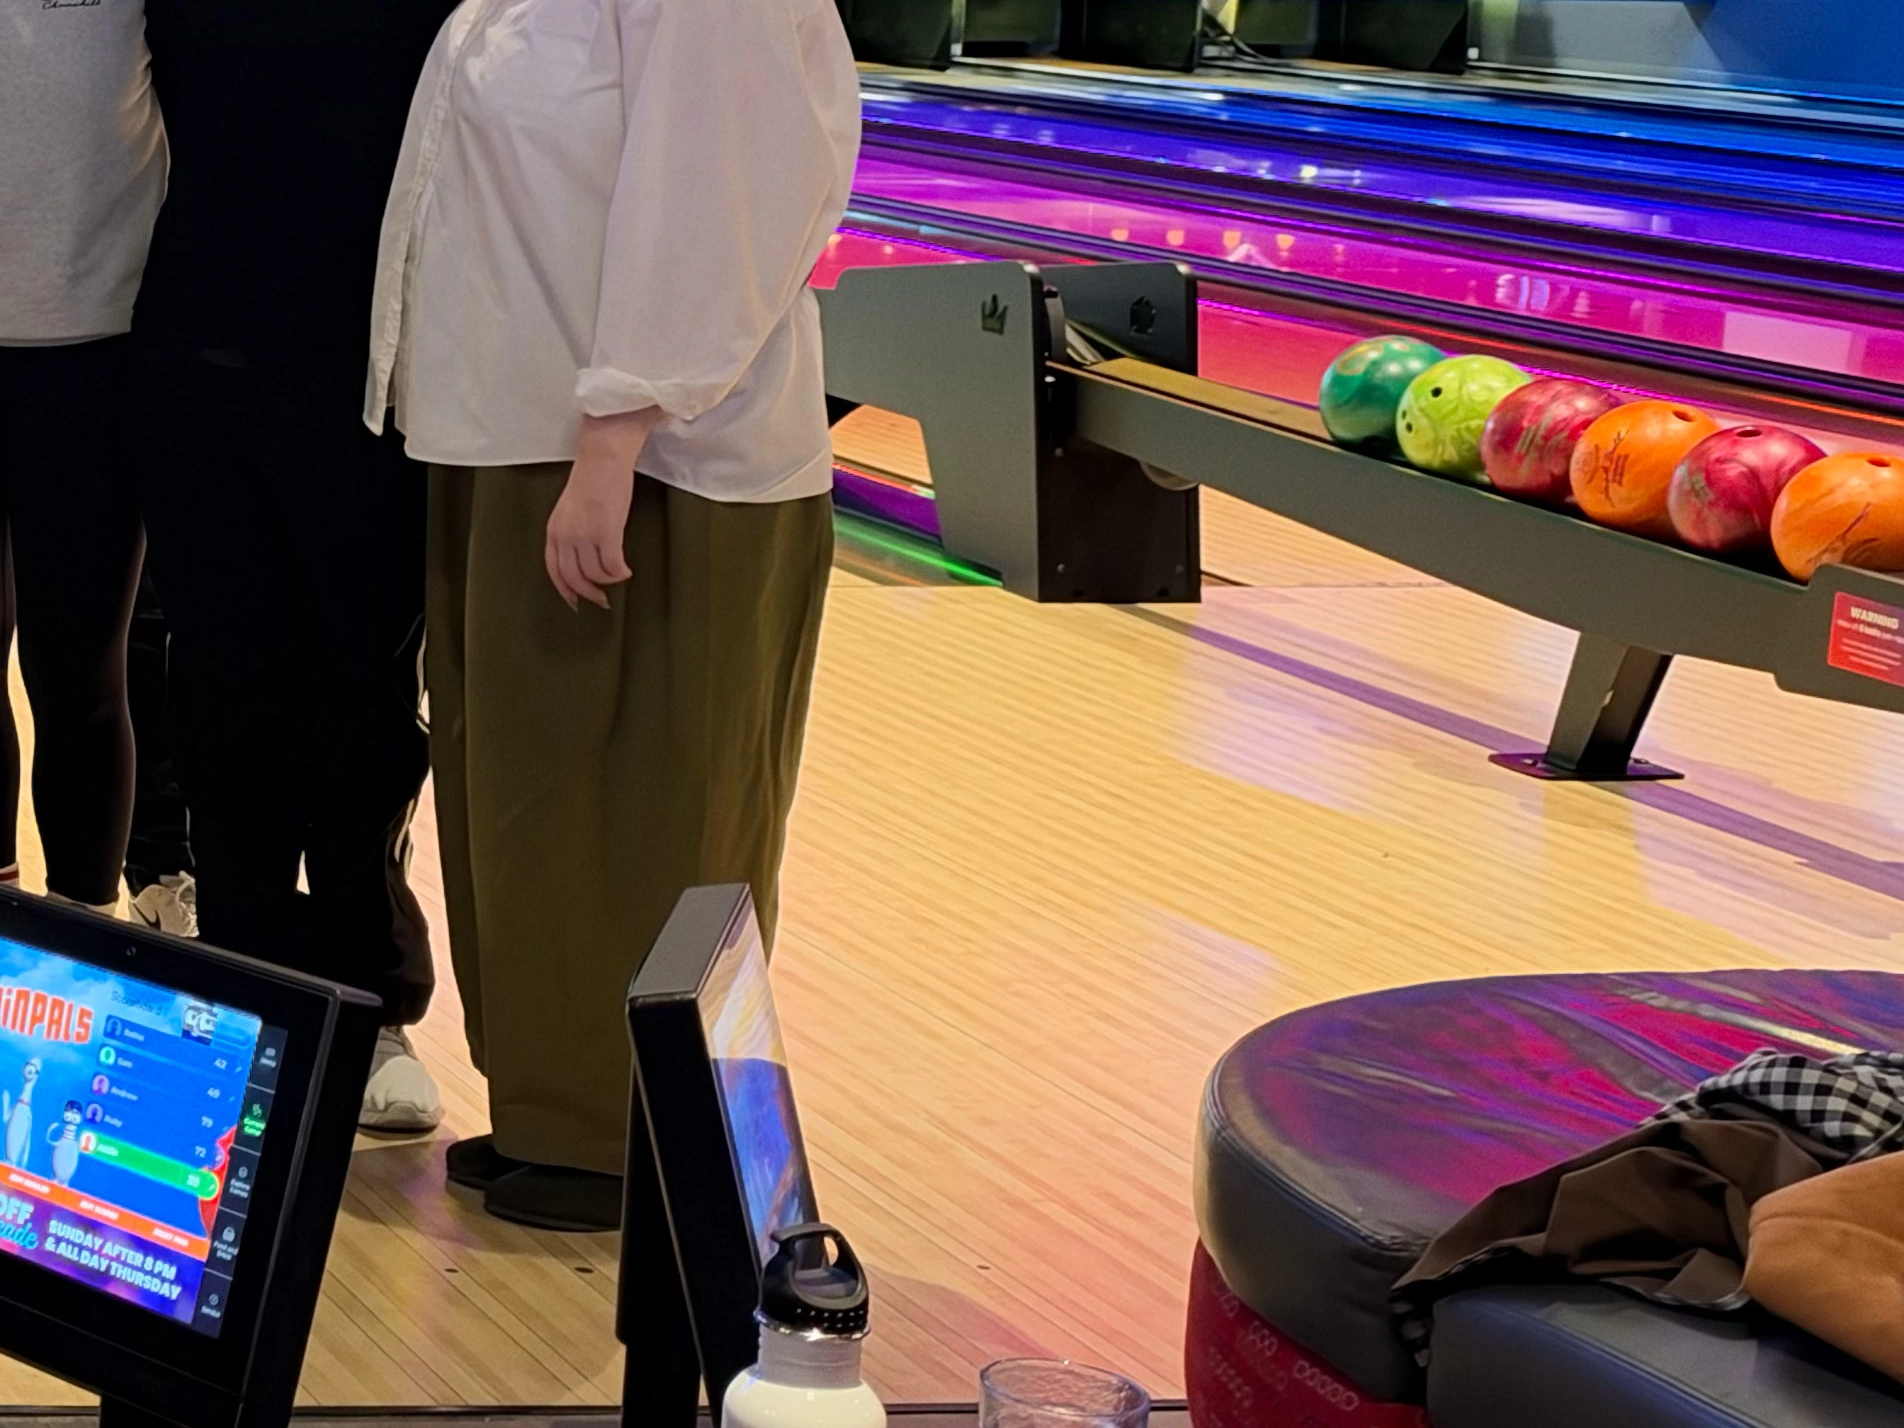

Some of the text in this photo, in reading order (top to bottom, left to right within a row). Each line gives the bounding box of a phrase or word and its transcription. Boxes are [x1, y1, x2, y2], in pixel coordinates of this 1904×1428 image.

[45, 1236, 182, 1301] & ALL DAY THURSDAY
[48, 1220, 102, 1250] SUNDAY
[103, 1237, 144, 1268] AFTER
[154, 1260, 177, 1281] PM
